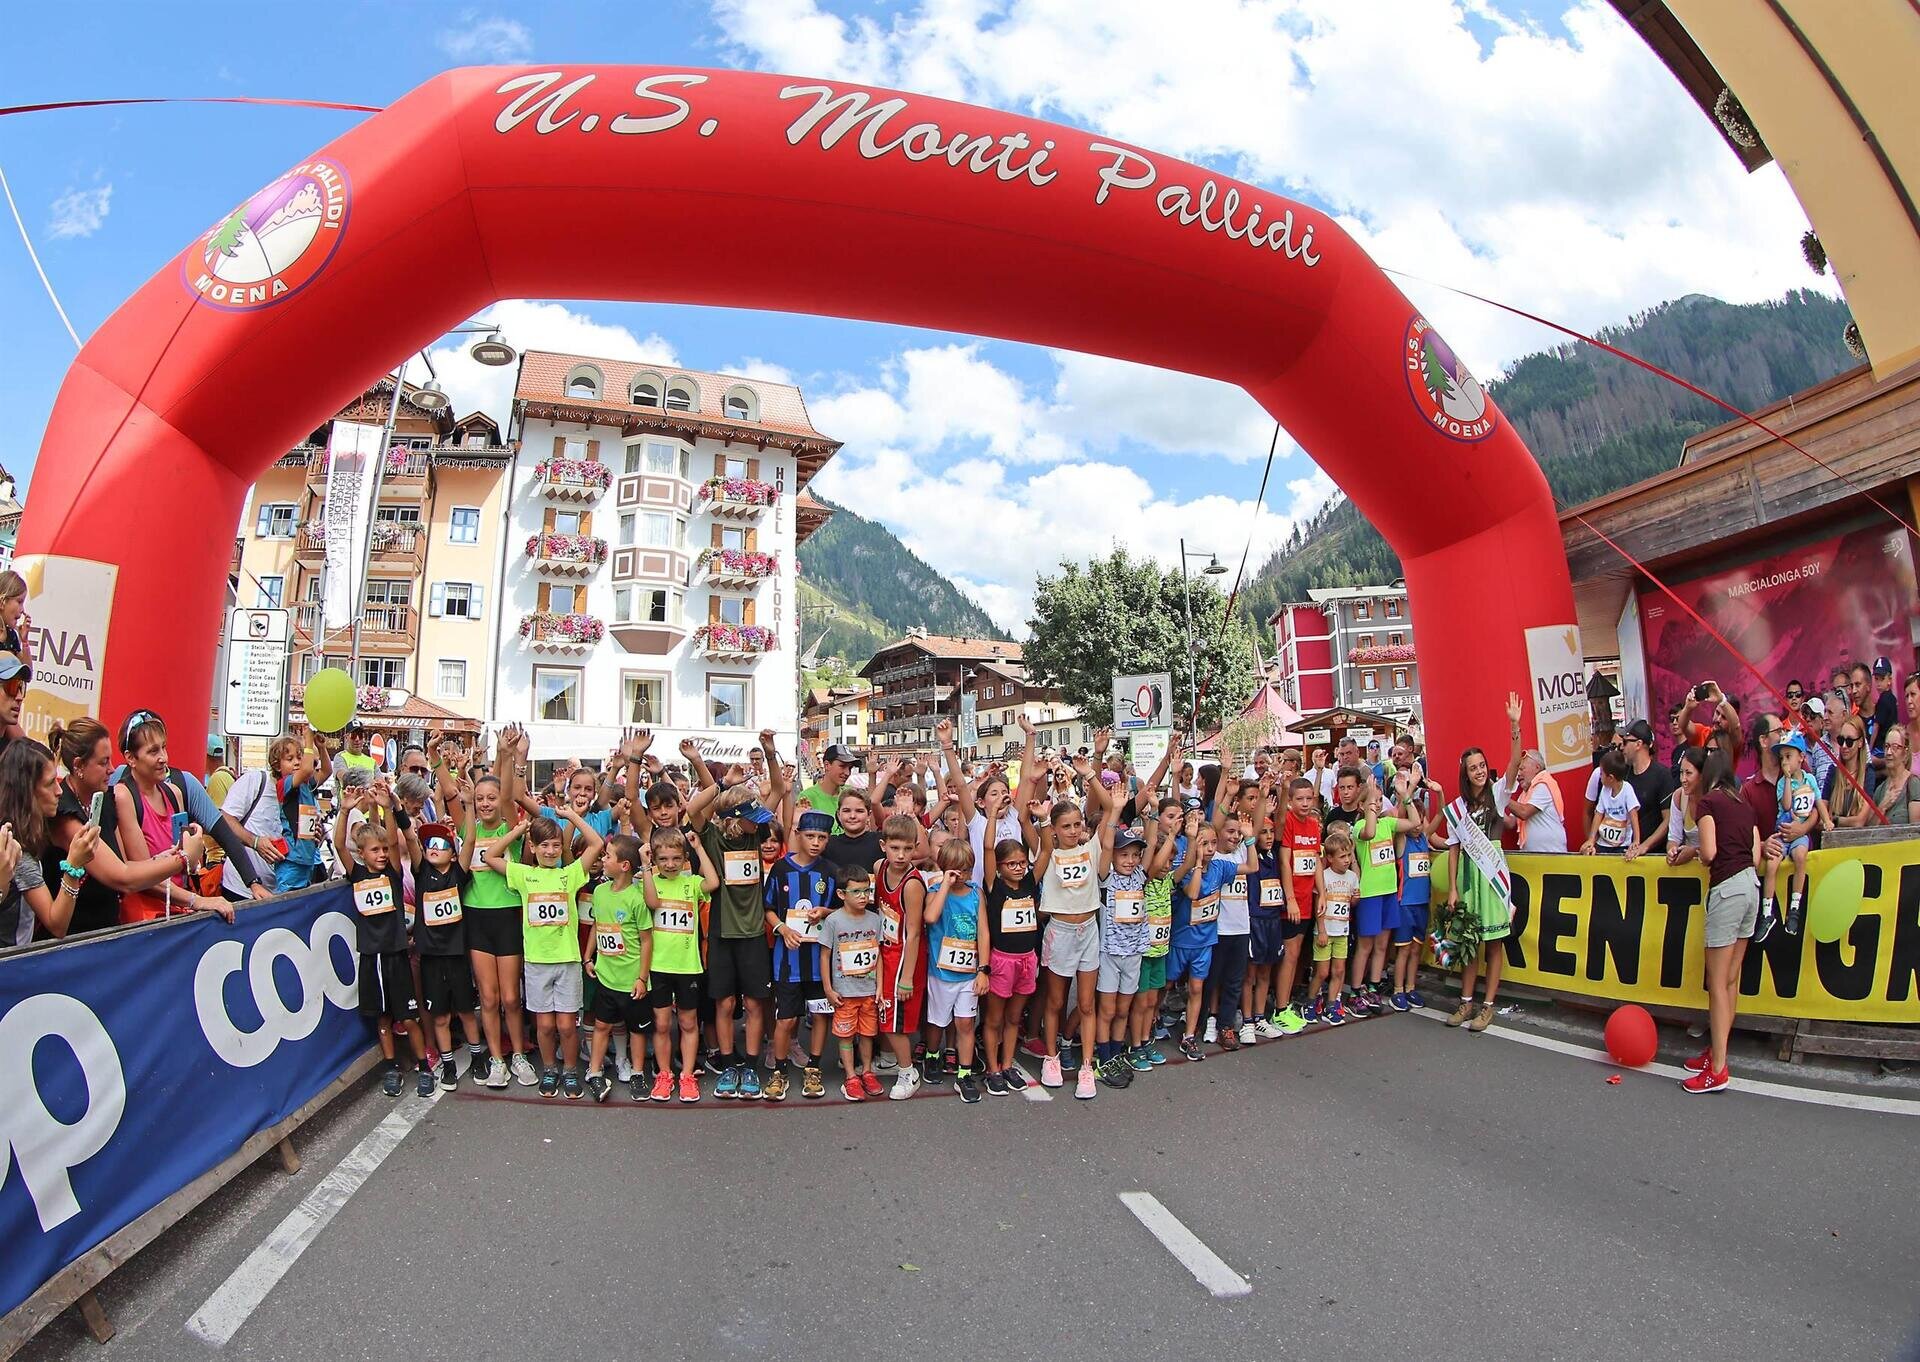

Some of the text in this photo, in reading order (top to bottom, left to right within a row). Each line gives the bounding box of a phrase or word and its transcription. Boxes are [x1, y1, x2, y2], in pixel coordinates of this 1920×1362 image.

[494, 72, 1321, 267] U.S. Monti Pallidi
[310, 163, 344, 229] PALLIDI
[195, 274, 289, 304] MOENA
[1432, 411, 1491, 437] MOENA
[774, 466, 784, 535] HOTEL
[1728, 562, 1821, 598] MARCIALONGA 50Y
[773, 549, 782, 651] FALORIA
[27, 626, 94, 672] ENA
[36, 670, 94, 691] DOLOMITI
[1537, 671, 1585, 701] MOE
[1370, 695, 1420, 706] HOTEL STEL
[1540, 706, 1551, 715] LA
[1552, 702, 1570, 712] FATA
[288, 713, 308, 723] ACIA
[357, 716, 432, 727] mporary OUTLET
[689, 737, 743, 757] Faloria
[1795, 796, 1809, 810] 23
[1603, 827, 1622, 841] 107
[1379, 848, 1391, 860] 67
[743, 863, 752, 877] 8
[1302, 859, 1313, 870] 30
[1417, 861, 1428, 872] 68
[1062, 866, 1081, 880] 52
[365, 890, 383, 907] 49
[434, 901, 453, 918] 60
[538, 904, 557, 919] 80
[1202, 904, 1216, 918] 57
[1333, 903, 1347, 915] 26
[660, 911, 688, 927] 114
[1014, 910, 1032, 925] 51
[1155, 926, 1170, 940] 88
[853, 951, 871, 967] 43
[949, 950, 973, 966] 132
[193, 911, 359, 1068] coo
[0, 993, 127, 1233] p
